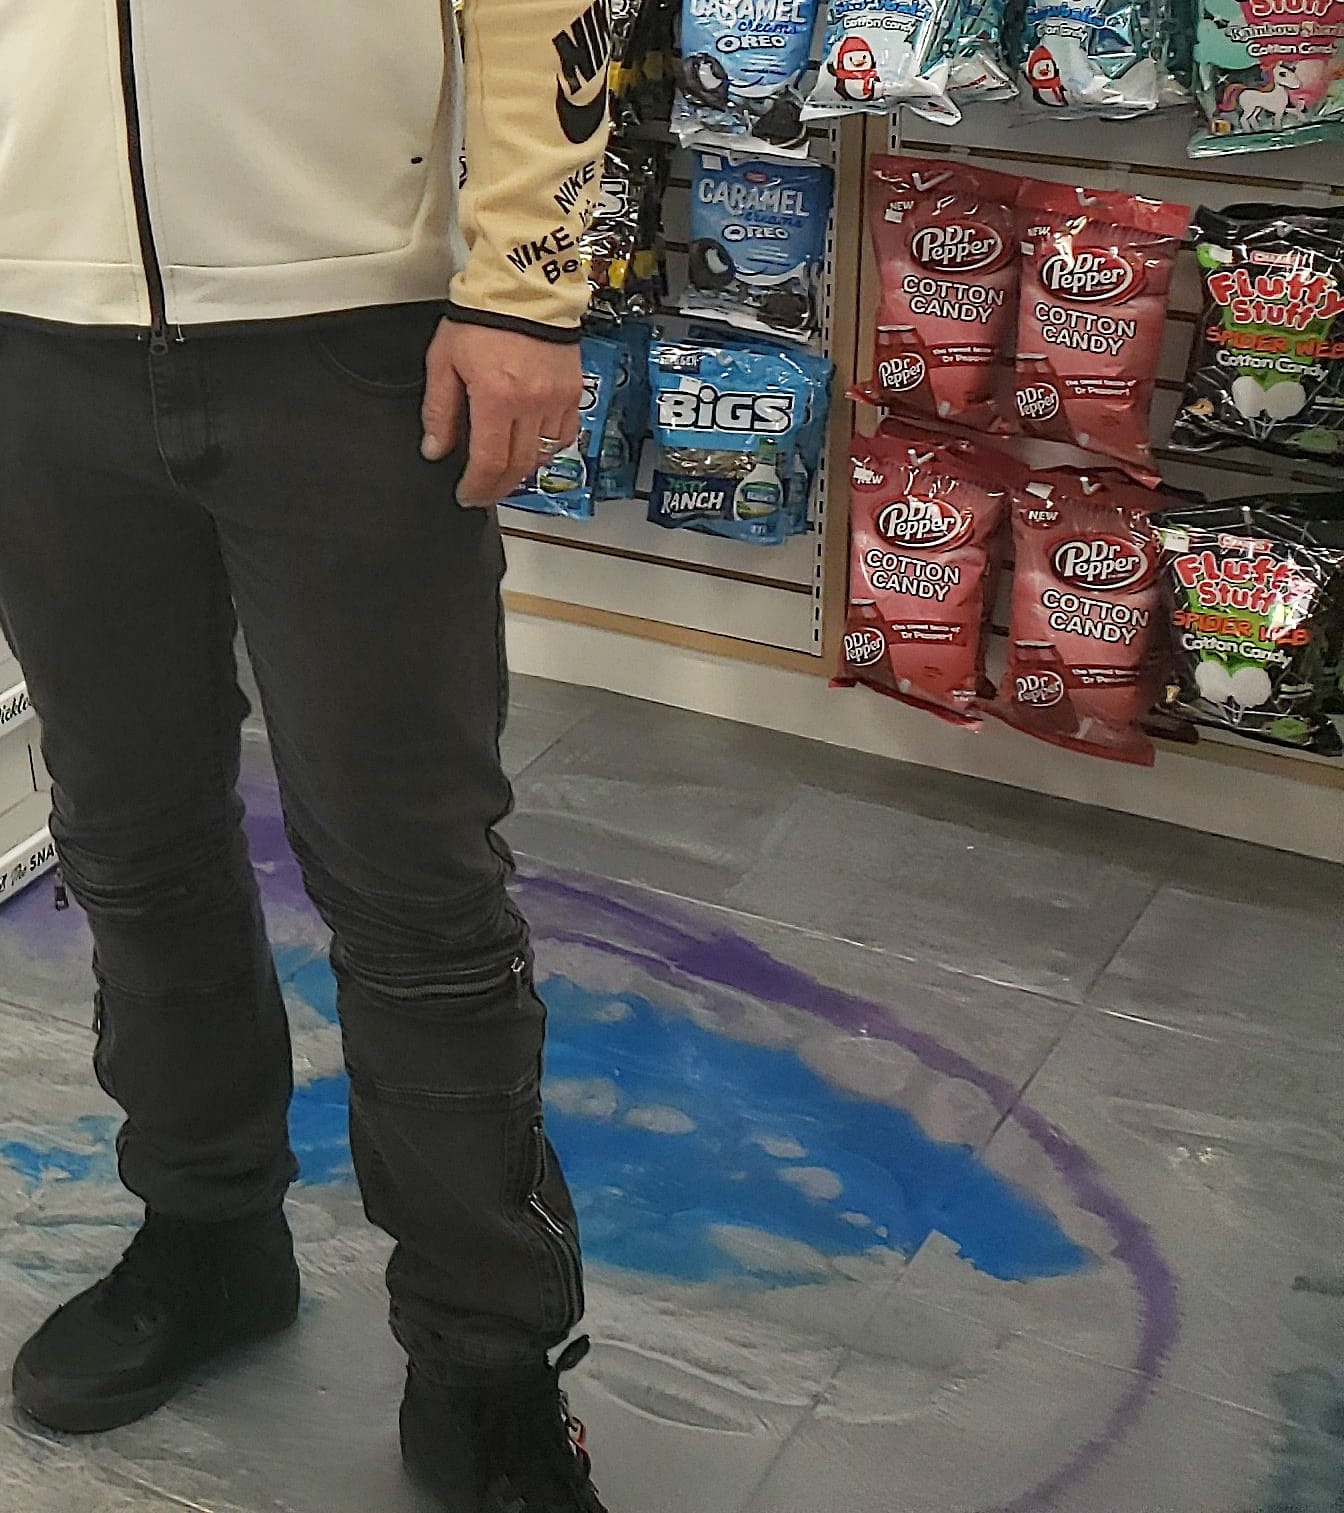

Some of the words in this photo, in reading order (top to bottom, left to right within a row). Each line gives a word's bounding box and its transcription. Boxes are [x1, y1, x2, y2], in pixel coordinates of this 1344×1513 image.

[715, 35, 786, 52] OREO
[1230, 23, 1297, 39] Rainbow
[554, 160, 596, 216] NIKE
[698, 178, 810, 217] CARAMEL
[889, 200, 914, 212] NEW
[722, 224, 789, 241] OREO
[914, 229, 996, 265] Pepper
[945, 227, 973, 247] Dr
[506, 226, 575, 273] NIKE
[1076, 254, 1106, 274] Dr
[1045, 258, 1127, 293] Pepper
[902, 276, 1005, 307] COTTON
[910, 296, 992, 323] CANDY
[1034, 303, 1136, 338] COTTON
[1231, 298, 1318, 329] Stuff
[1041, 325, 1125, 357] CANDY
[1206, 326, 1287, 355] SPIDER
[879, 361, 923, 389] Pepper
[890, 359, 911, 373] Dr
[1215, 350, 1273, 370] Cotton
[1274, 357, 1329, 381] Candy
[1016, 391, 1058, 420] Pepper
[1024, 388, 1046, 403] Dr
[660, 490, 724, 514] RANCH
[907, 496, 940, 520] Dr
[1027, 509, 1059, 523] NEW
[881, 506, 957, 538] Pepper
[1056, 547, 1140, 581] Pepper
[1088, 541, 1122, 563] Dr
[865, 549, 961, 586] COTTON
[871, 572, 950, 602] CANDY
[1198, 583, 1281, 611] Stuff
[1041, 589, 1149, 627] COTTON
[852, 632, 871, 647] Dr
[1049, 612, 1138, 645] CANDY
[1173, 610, 1252, 640] SPIDER
[844, 634, 884, 663] Pepper
[1183, 632, 1239, 655] Cotton
[1239, 642, 1293, 668] Candy
[1027, 676, 1049, 691] Dr
[29, 843, 55, 873] SNA
